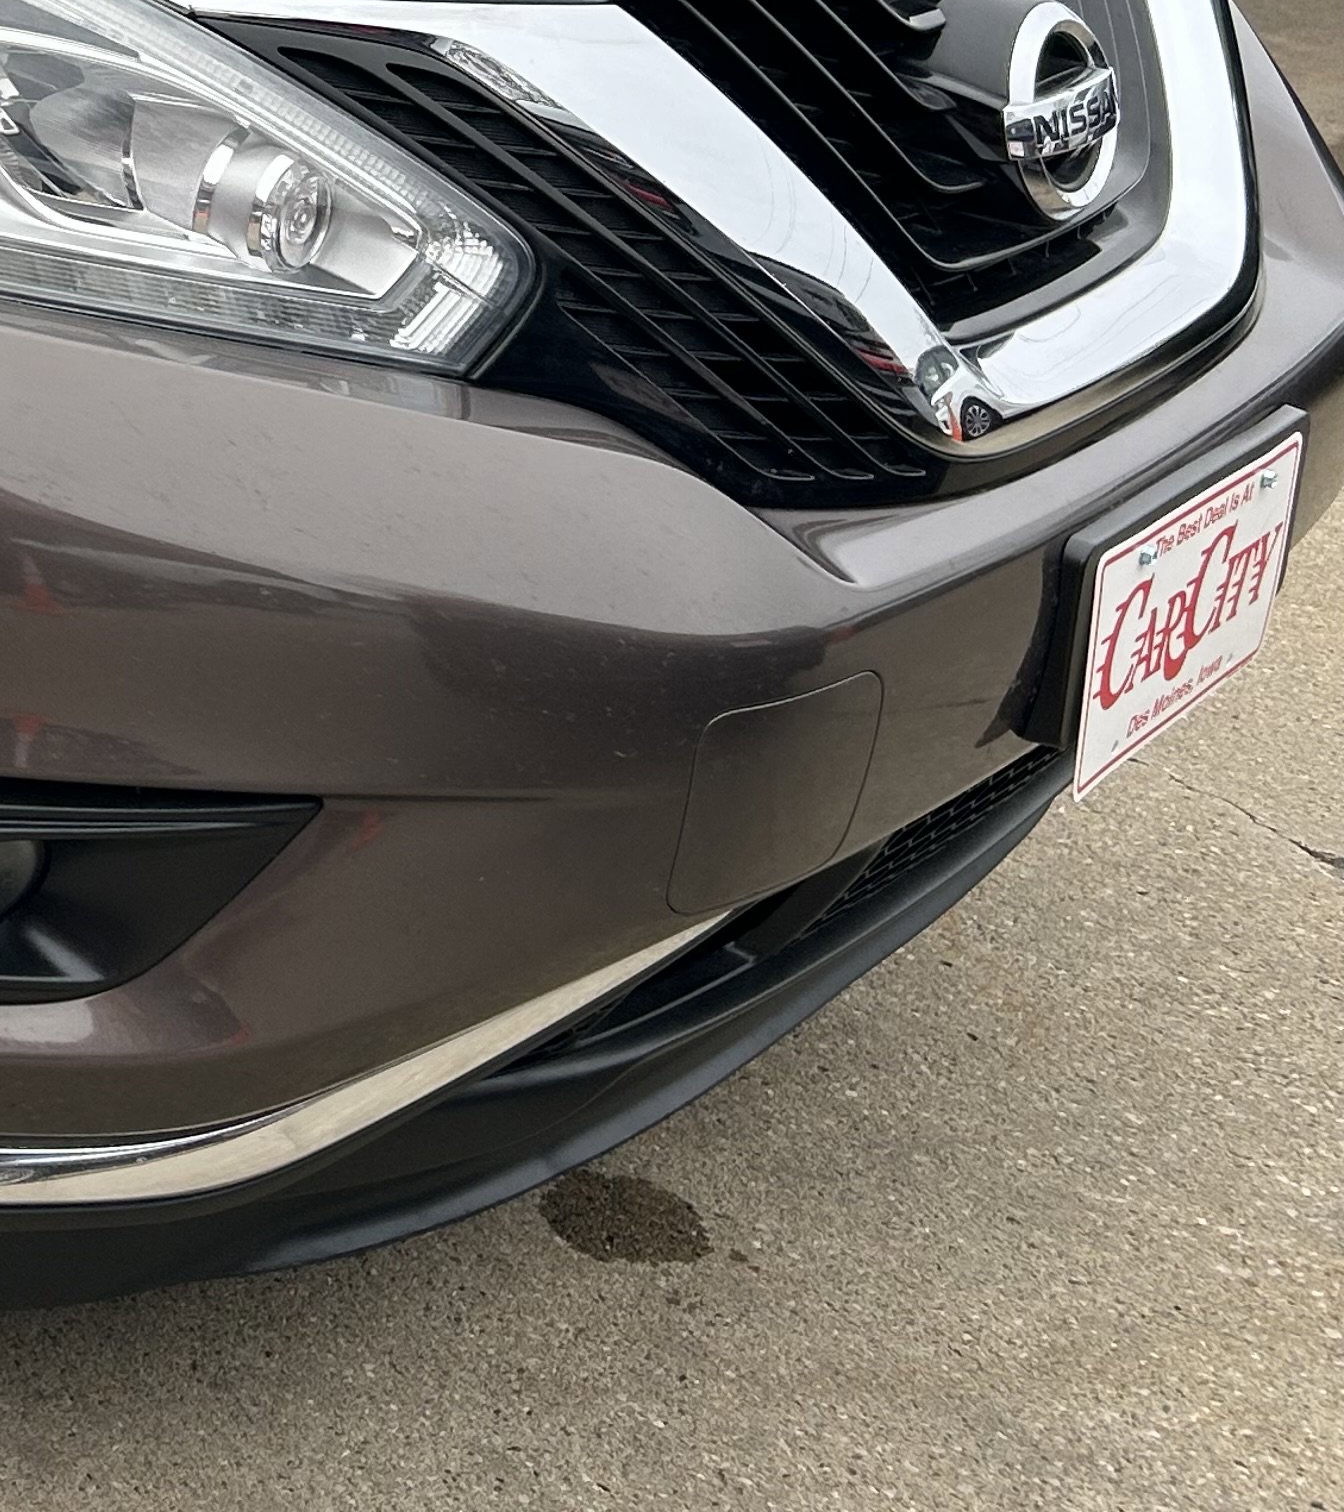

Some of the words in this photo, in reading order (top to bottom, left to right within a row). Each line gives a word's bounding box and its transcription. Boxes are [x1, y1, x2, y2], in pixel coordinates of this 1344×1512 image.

[1156, 535, 1175, 557] The
[1176, 513, 1203, 545] Best
[1203, 497, 1230, 529] Deal
[1230, 493, 1241, 513] Is
[1240, 482, 1254, 506] At
[1126, 709, 1150, 738] Des
